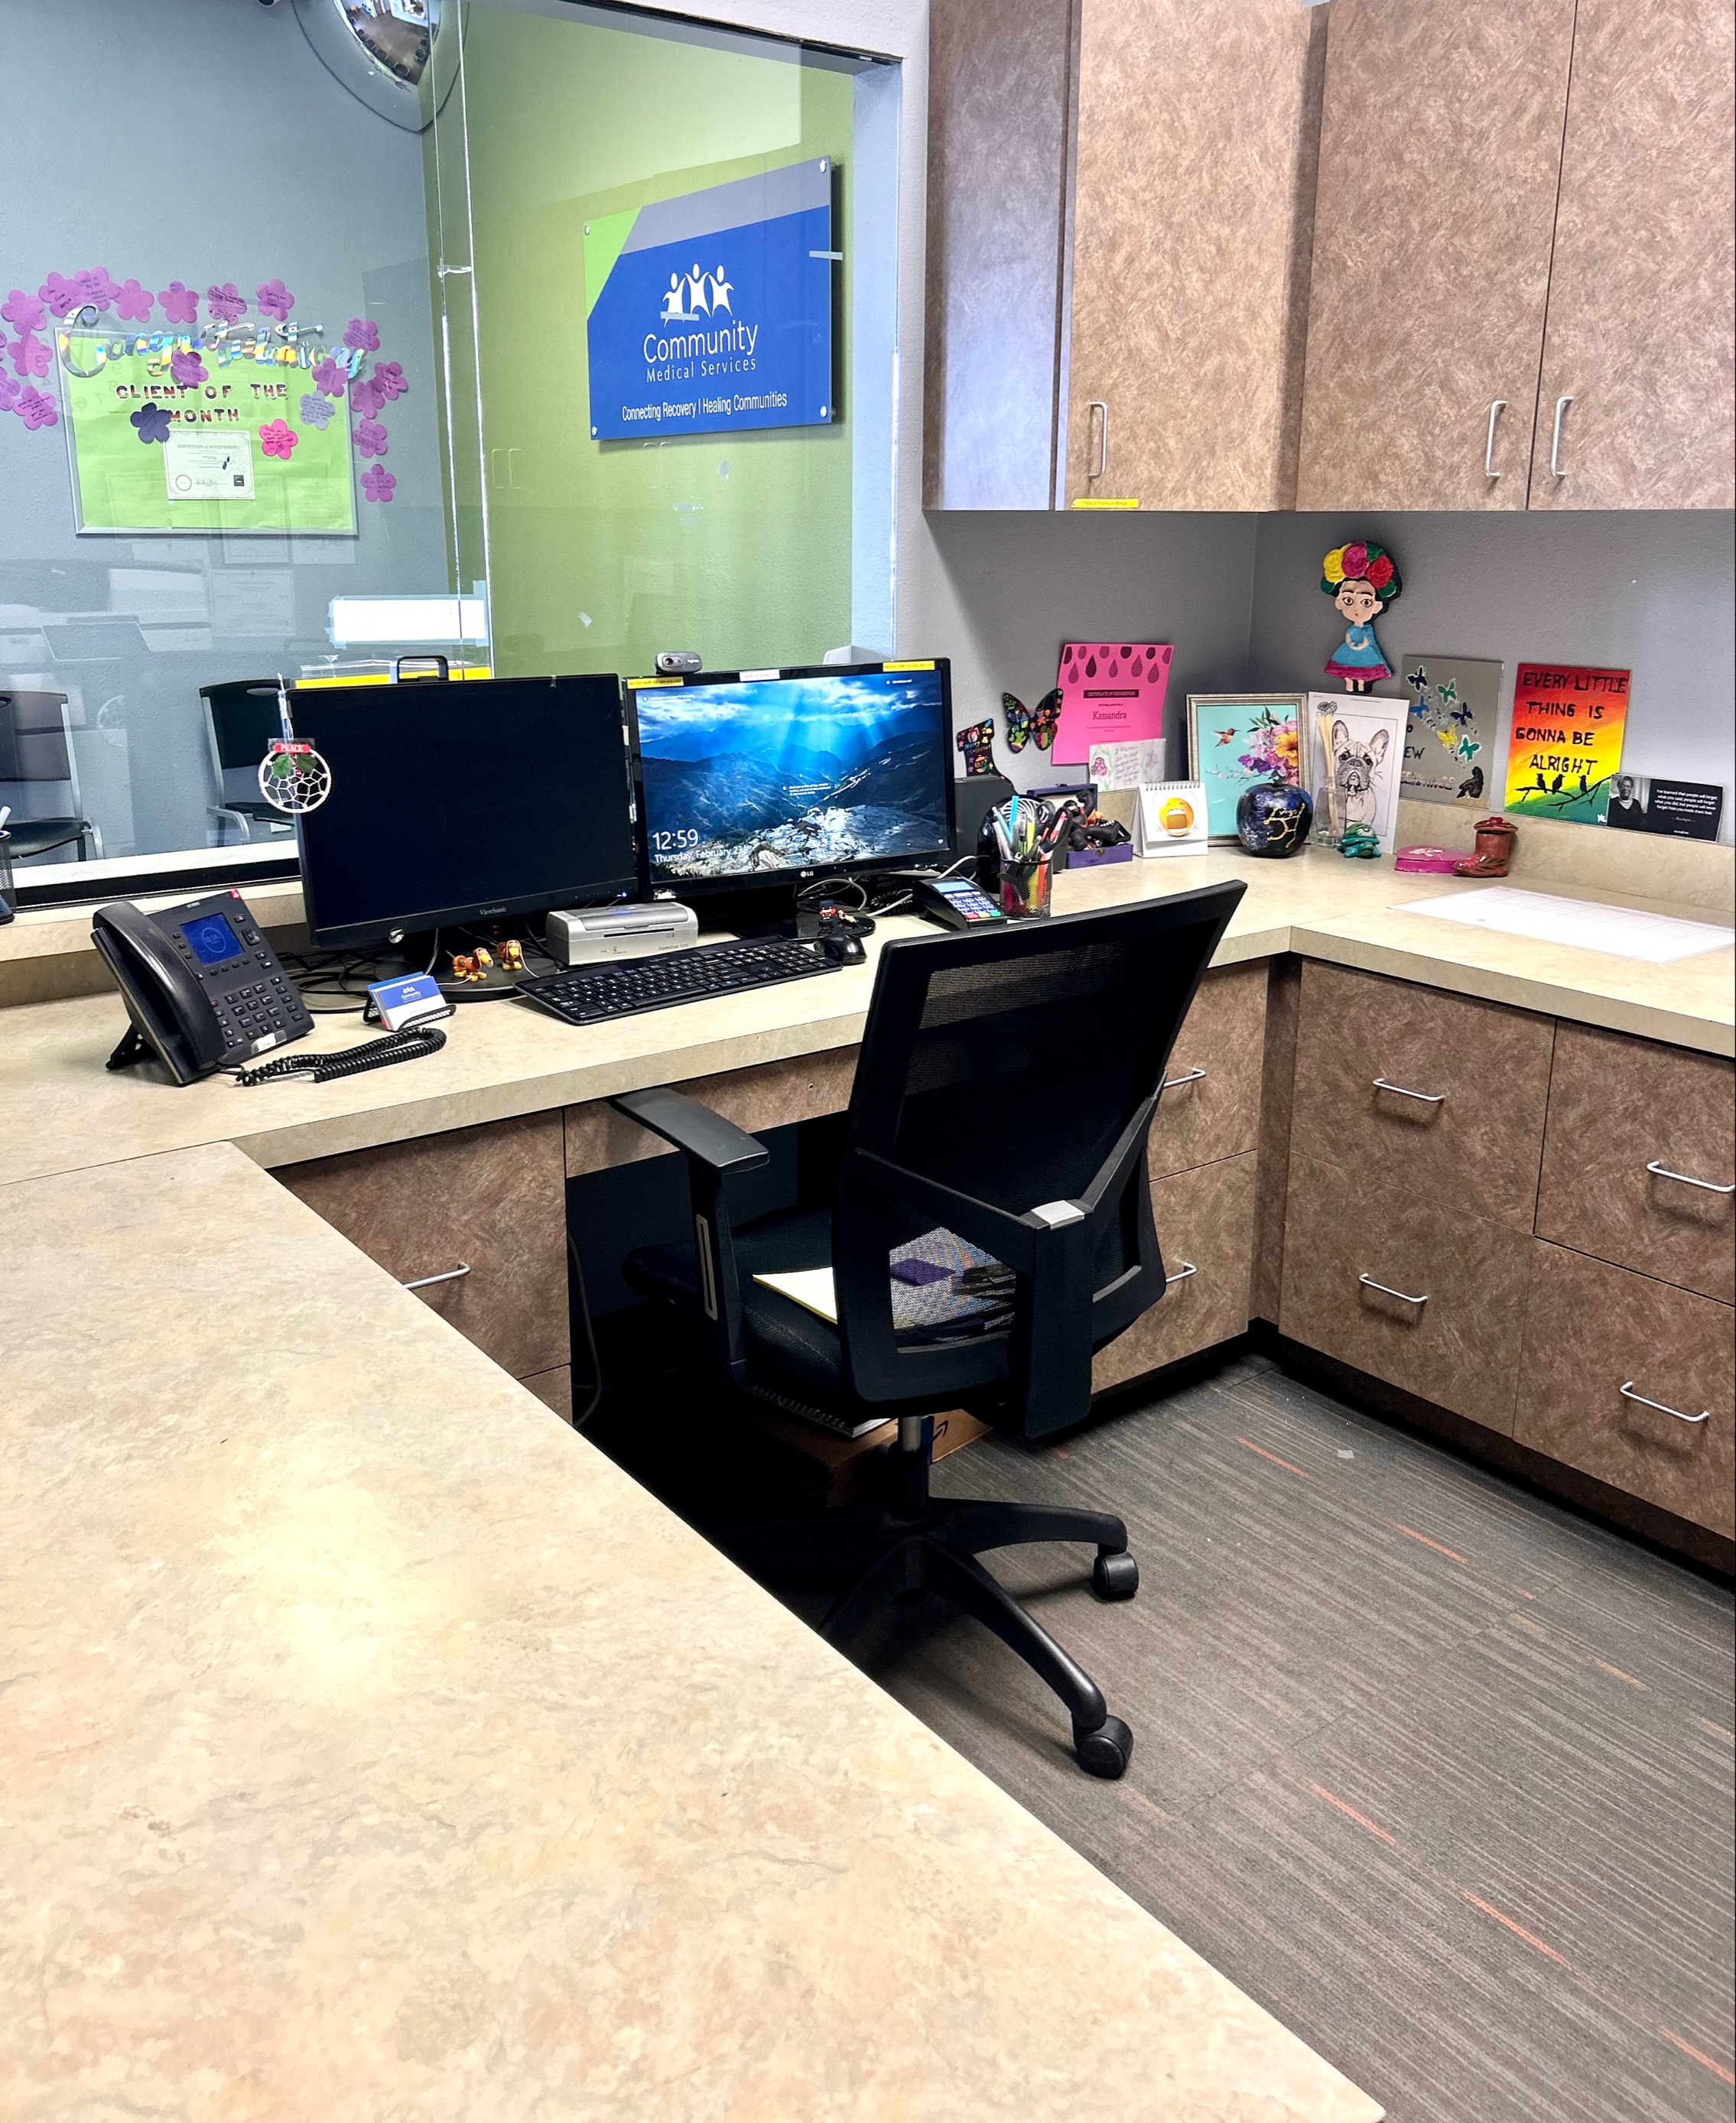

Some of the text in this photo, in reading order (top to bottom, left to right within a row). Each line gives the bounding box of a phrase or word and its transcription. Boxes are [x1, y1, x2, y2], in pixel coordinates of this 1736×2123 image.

[643, 320, 758, 363] Community
[646, 356, 756, 382] Medical Services
[115, 383, 288, 399] CLIENT OF THE
[168, 408, 240, 423] MONTH
[622, 403, 662, 421] Connecting
[662, 402, 697, 418] Recovery
[703, 396, 732, 416] Healing
[733, 391, 788, 411] Communities
[1523, 671, 1628, 694] EVERY LITTLE
[1093, 710, 1126, 720] Kassandra
[1526, 701, 1604, 720] THING IS
[1515, 727, 1595, 746] GONNA BE
[1404, 746, 1426, 759] EW
[1530, 754, 1598, 775] ALRIGHT
[652, 828, 699, 850] 12:59
[655, 846, 743, 863] Thursday, February 23
